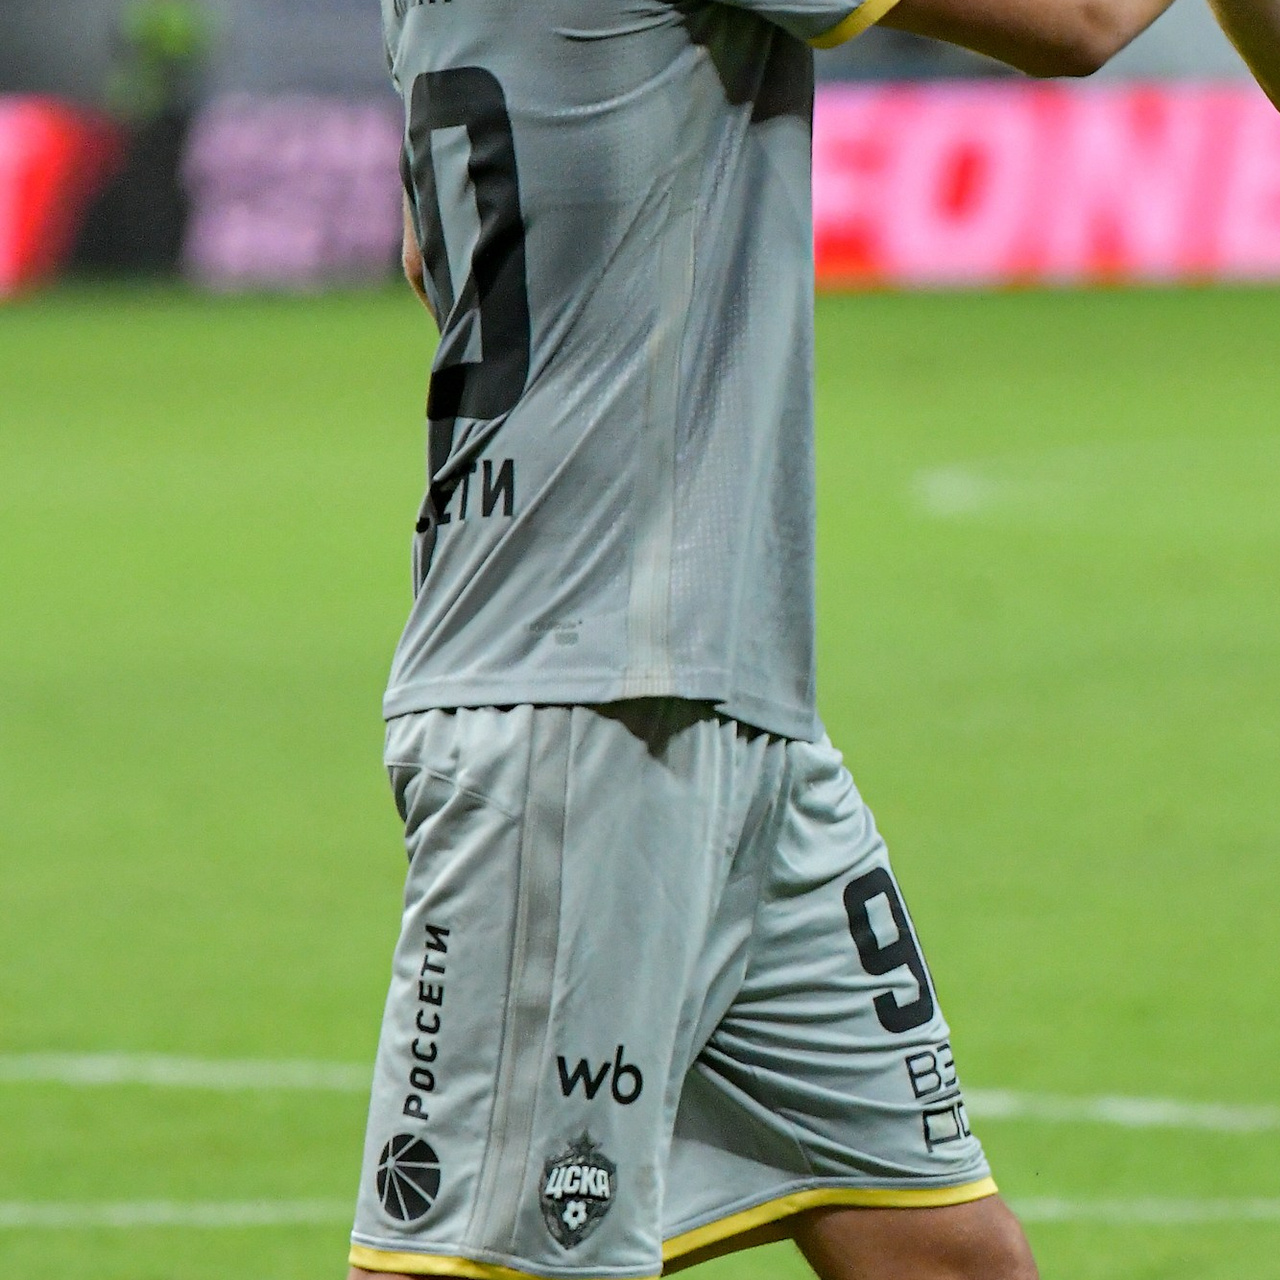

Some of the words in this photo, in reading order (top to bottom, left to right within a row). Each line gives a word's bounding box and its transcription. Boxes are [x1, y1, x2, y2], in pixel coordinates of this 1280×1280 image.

[842, 866, 935, 1034] 9
[402, 922, 451, 1121] РОССЕТИ
[556, 1044, 643, 1105] wb
[544, 1164, 611, 1200] ЦСКА
